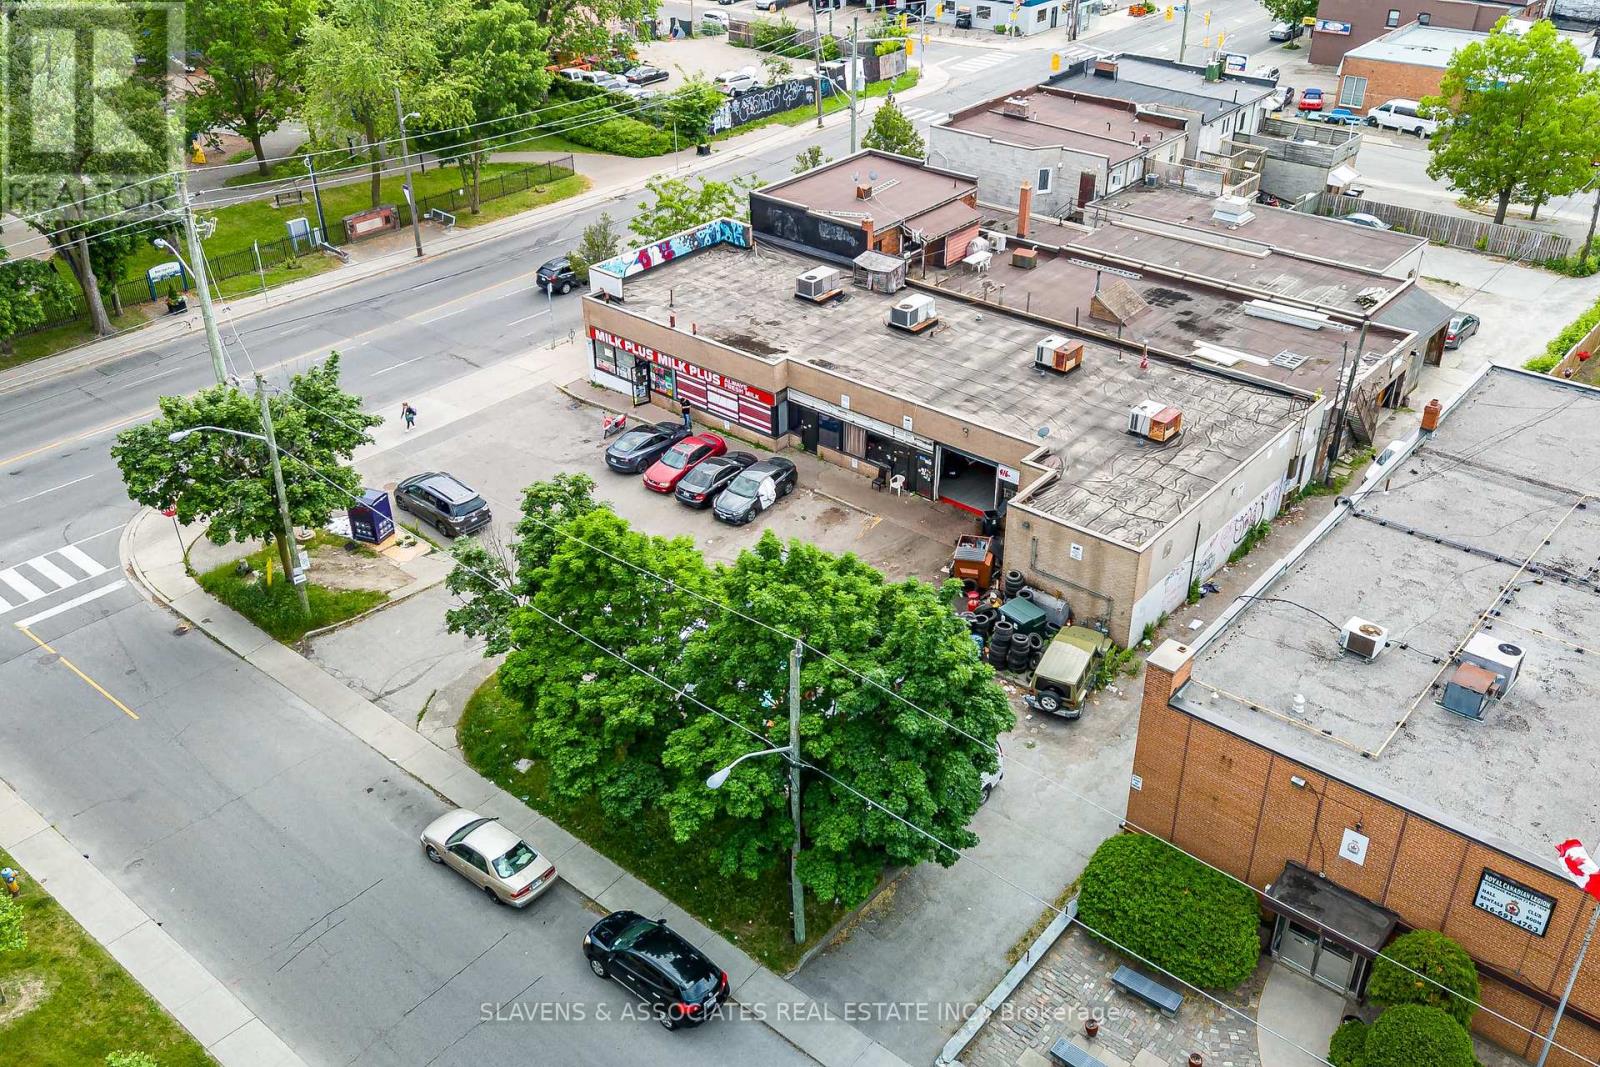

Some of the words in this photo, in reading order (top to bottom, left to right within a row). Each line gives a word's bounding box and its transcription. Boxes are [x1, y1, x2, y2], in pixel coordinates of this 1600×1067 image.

[595, 329, 621, 349] MILK
[625, 341, 654, 361] PLUS
[657, 352, 686, 374] MILK
[689, 364, 721, 385] PLUS
[724, 377, 748, 390] ALWAYS
[724, 383, 744, 395] FRESH
[744, 388, 760, 400] MILK
[1481, 888, 1496, 897] HALL
[1485, 874, 1502, 887] ROYAL
[1504, 881, 1531, 899] CANADIAN
[1531, 895, 1551, 909] LEGION
[1480, 895, 1503, 908] RENTALS
[1479, 902, 1539, 933] 416-691-4763
[1526, 916, 1542, 925] ROOM
[1528, 909, 1542, 919] CLUB
